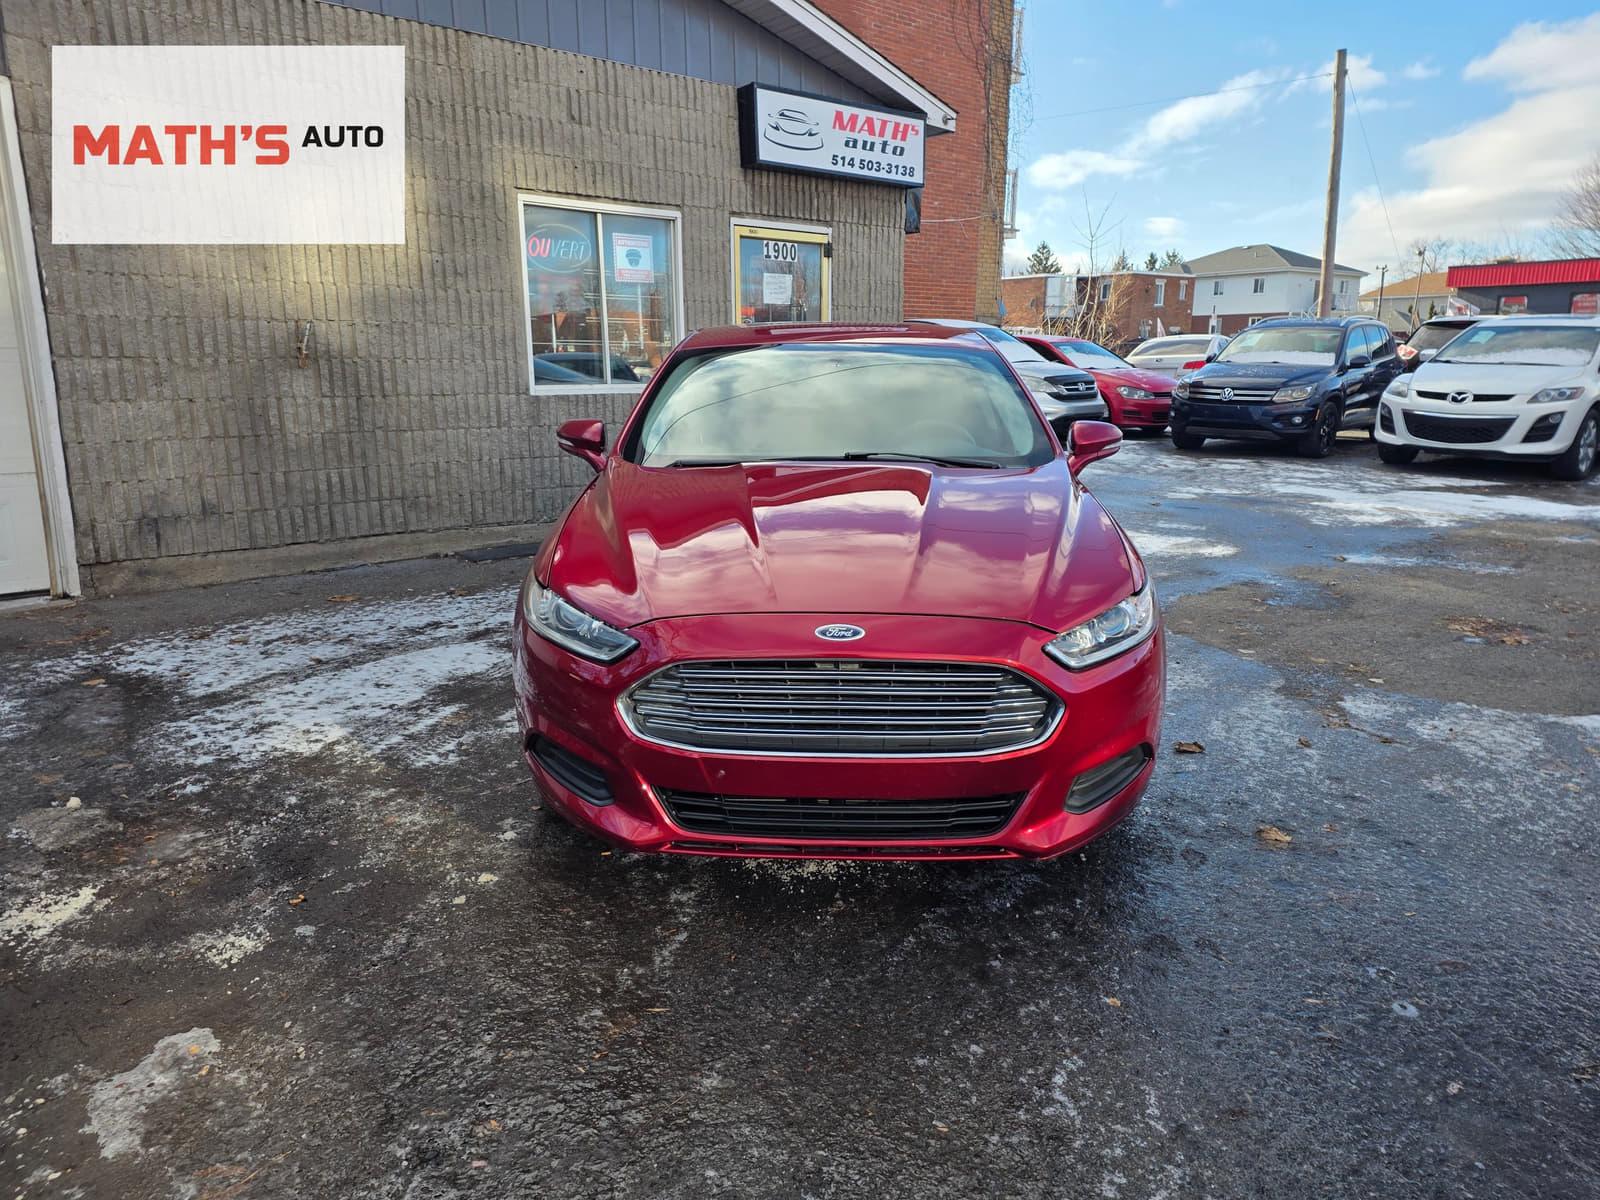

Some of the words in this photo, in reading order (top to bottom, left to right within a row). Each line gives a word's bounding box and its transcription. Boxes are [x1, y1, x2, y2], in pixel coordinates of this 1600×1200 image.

[844, 136, 905, 157] auto
[831, 154, 855, 168] 514
[858, 158, 915, 177] 503-3138
[528, 236, 586, 261] OUVERT
[764, 241, 797, 261] 1900
[825, 626, 854, 637] Ford
